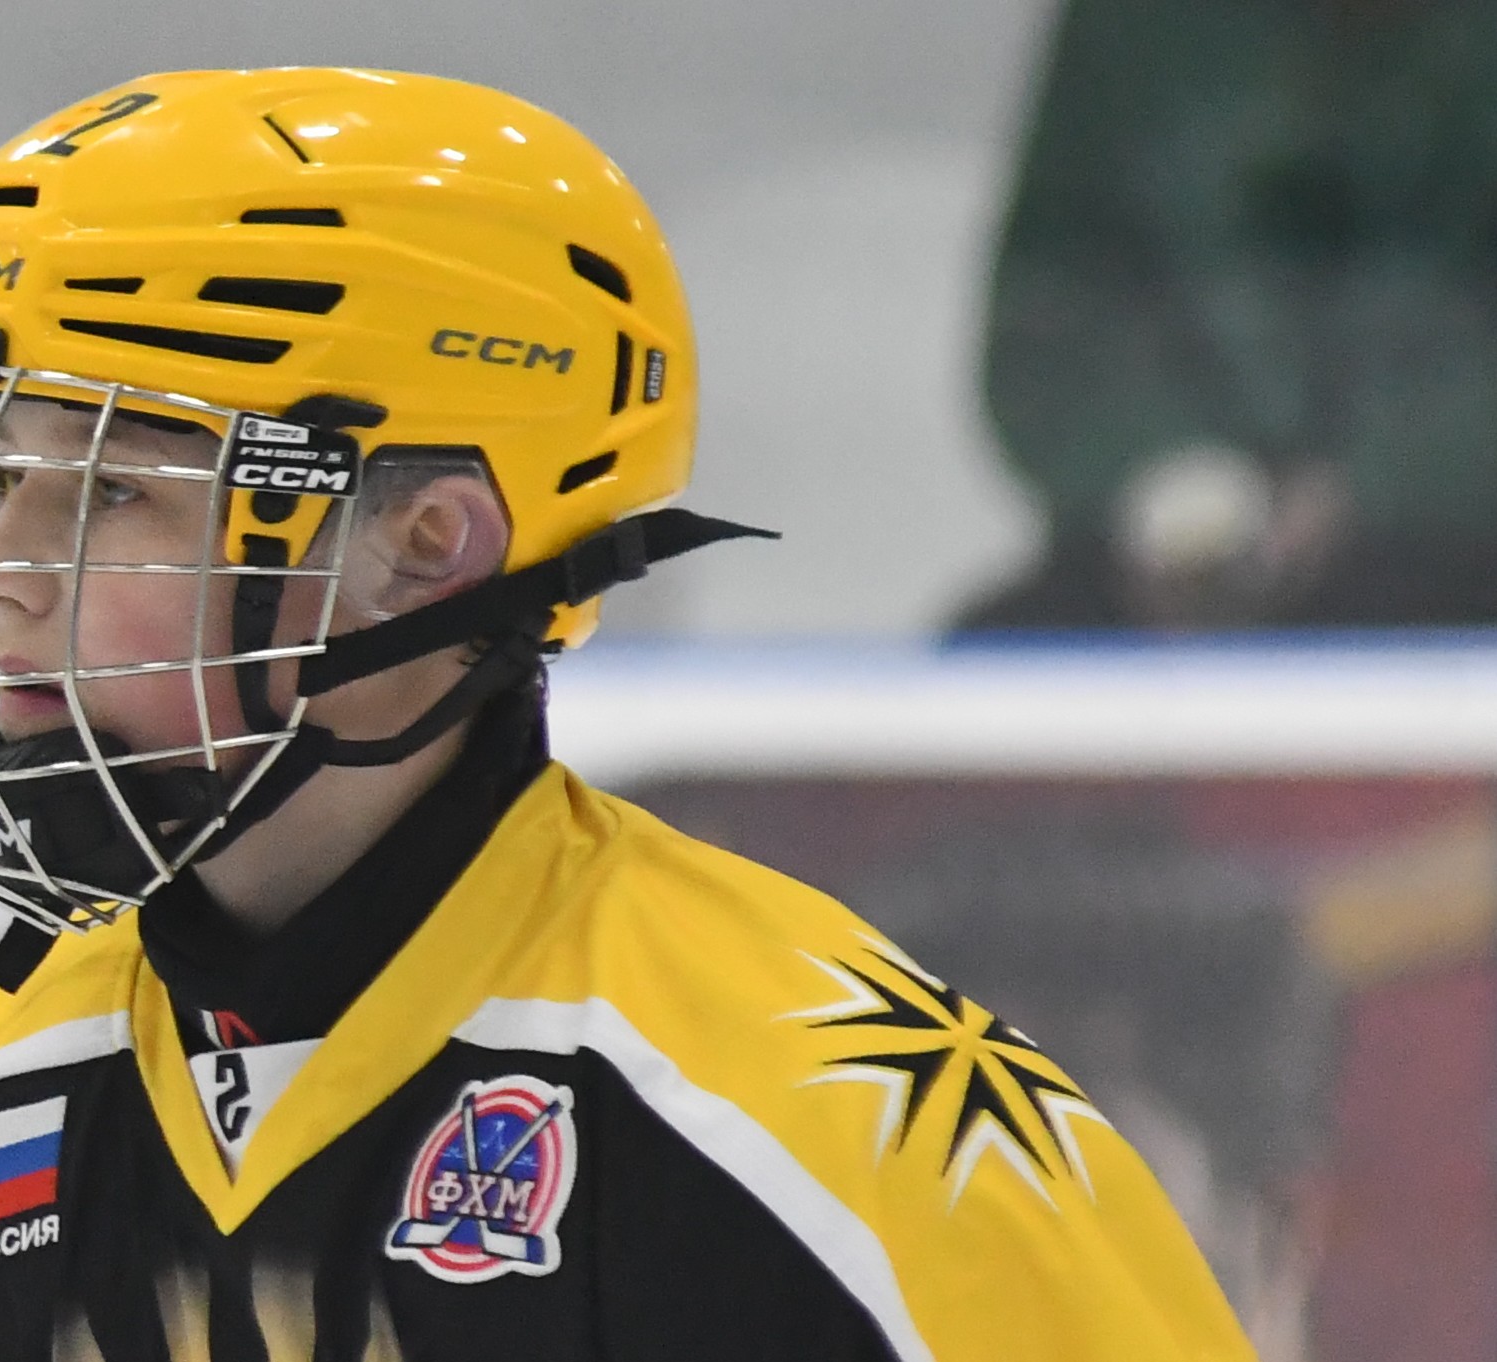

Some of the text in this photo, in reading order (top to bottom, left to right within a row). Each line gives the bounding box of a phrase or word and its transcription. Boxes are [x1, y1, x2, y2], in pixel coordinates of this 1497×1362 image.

[430, 328, 576, 374] CCM
[233, 463, 351, 491] CCM
[215, 1052, 252, 1144] 2
[427, 1170, 536, 1224] ФХМ
